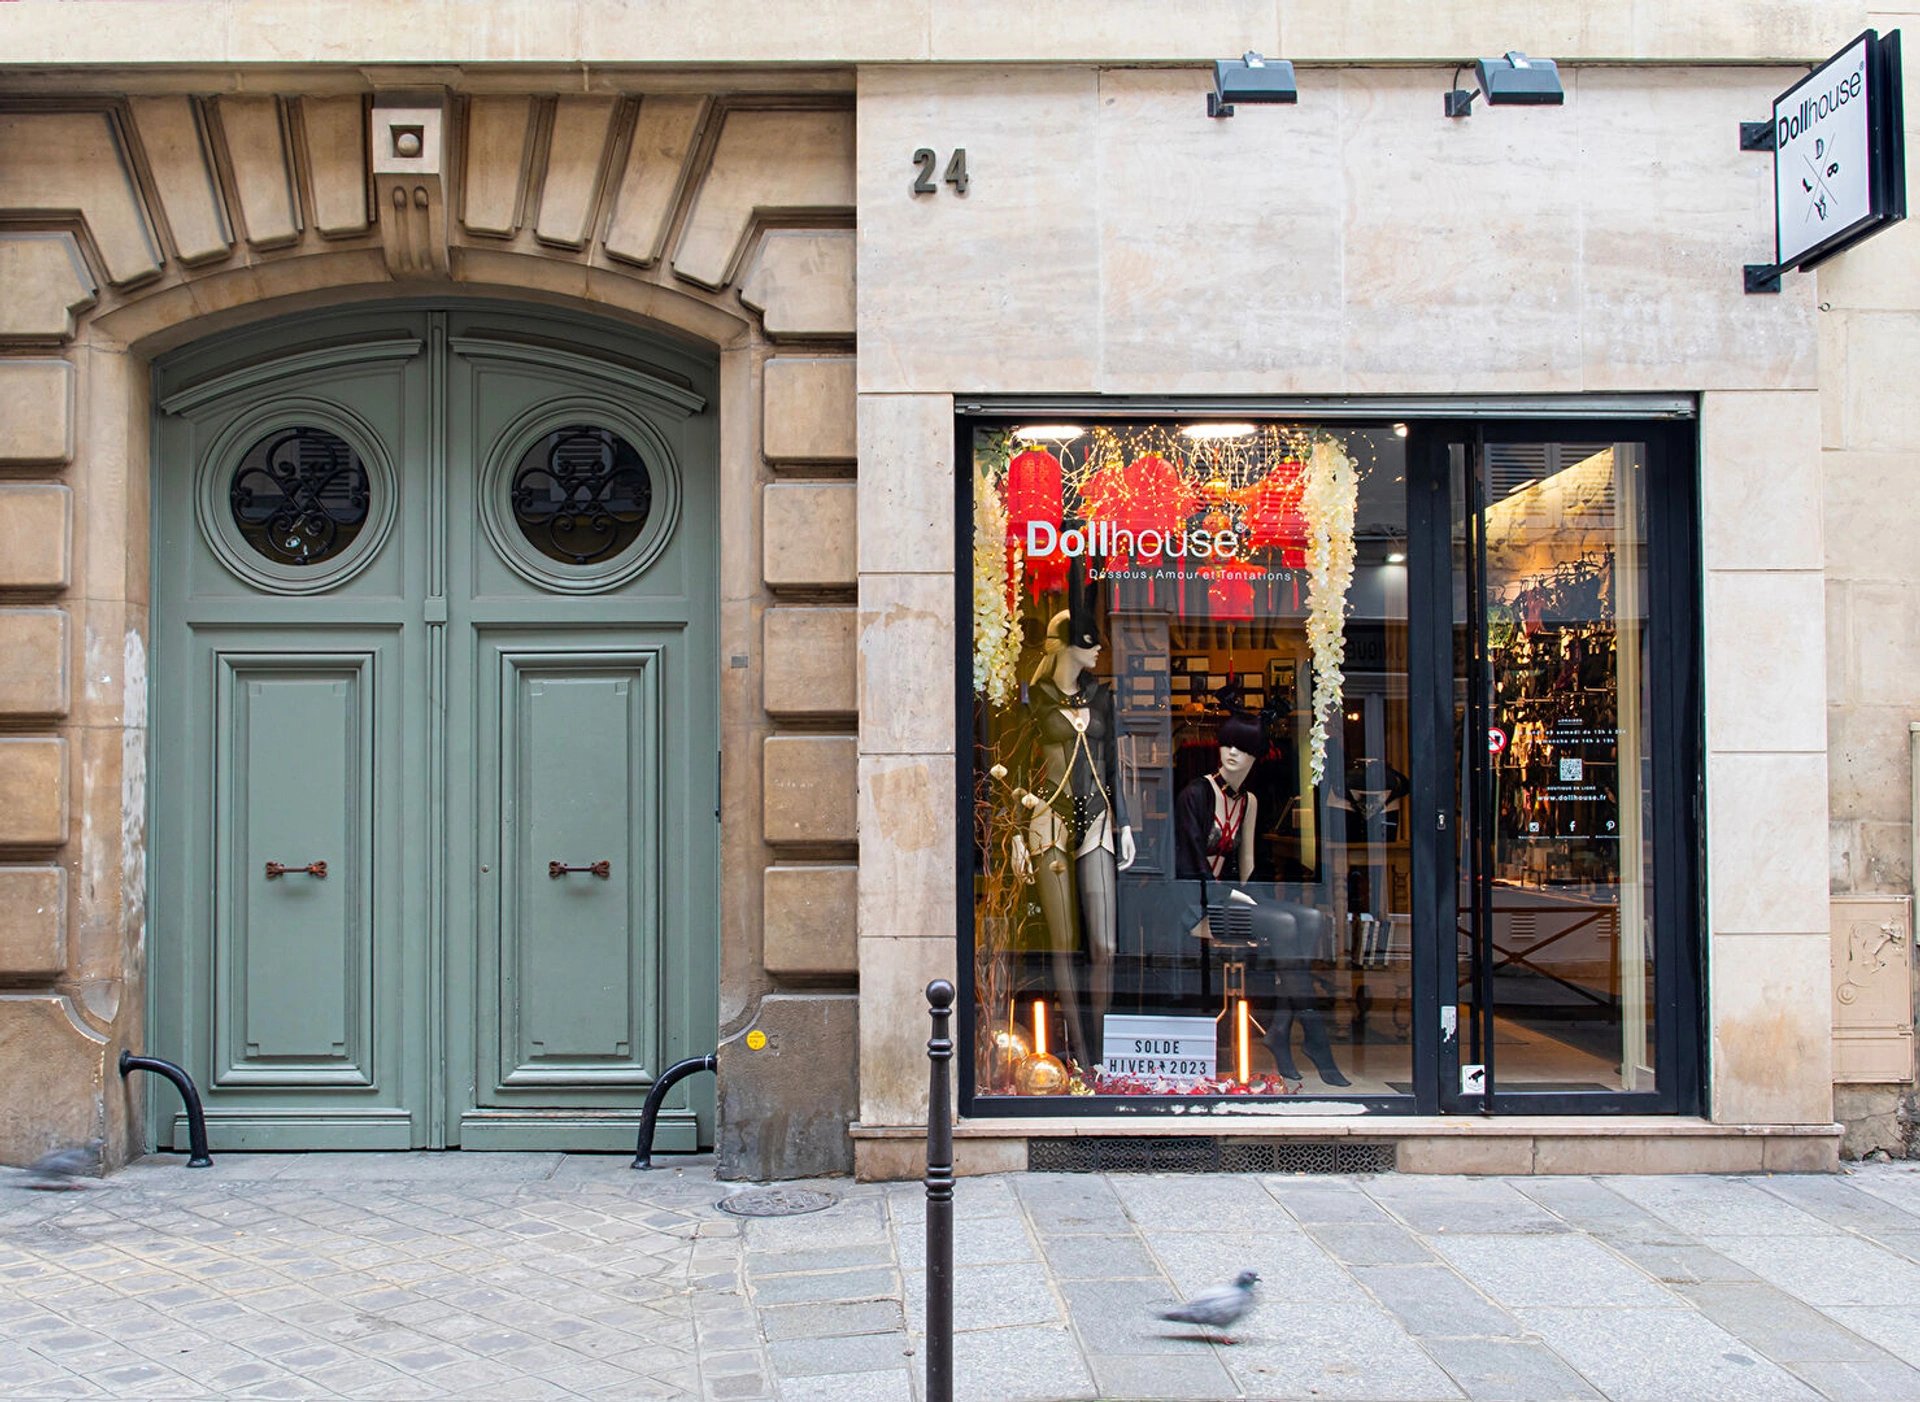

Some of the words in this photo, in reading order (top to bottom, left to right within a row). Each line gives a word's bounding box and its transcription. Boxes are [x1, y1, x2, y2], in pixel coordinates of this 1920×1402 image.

[913, 148, 968, 192] 24
[1155, 569, 1199, 580] Amour
[1202, 570, 1215, 580] et
[1220, 569, 1291, 581] Tentations
[1135, 1040, 1180, 1054] SOLDE
[1109, 1059, 1155, 1074] HIVER
[1170, 1061, 1206, 1075] 2023
